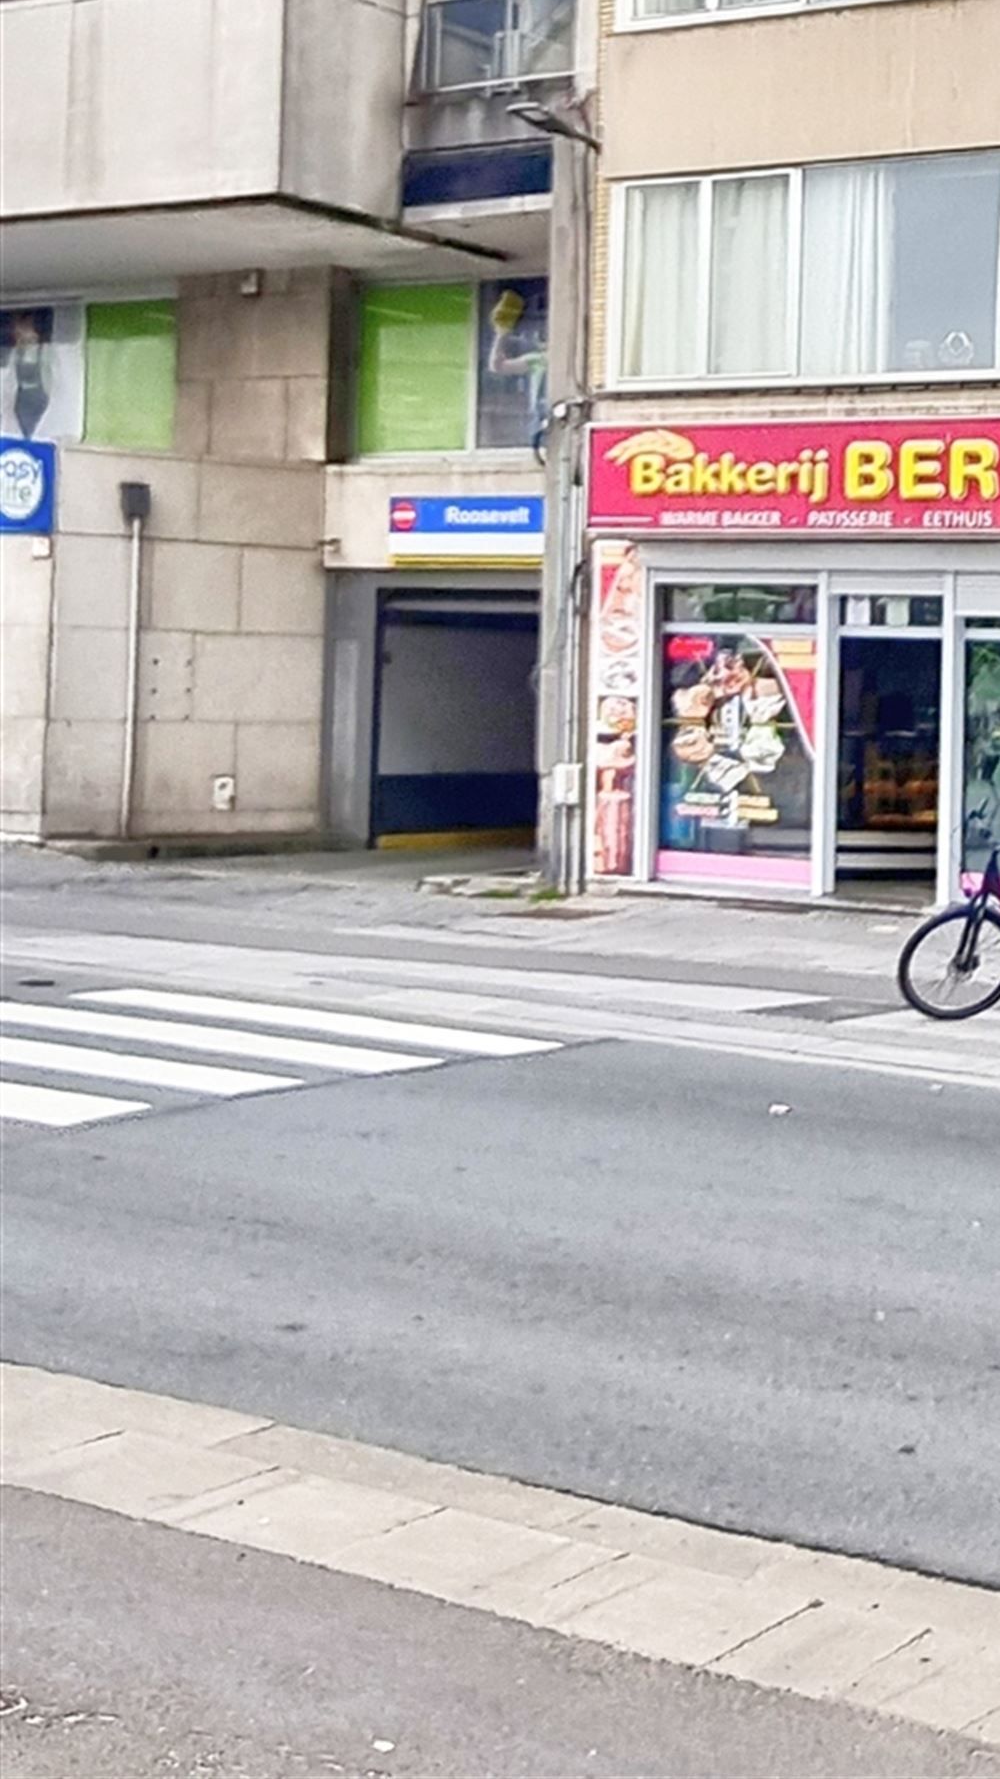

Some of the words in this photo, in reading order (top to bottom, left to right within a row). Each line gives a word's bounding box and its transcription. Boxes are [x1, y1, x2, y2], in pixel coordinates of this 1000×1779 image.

[630, 449, 829, 503] Bakkerij
[445, 505, 530, 525] Roosevelt
[659, 511, 718, 526] WARME
[720, 511, 782, 526] BAKKER
[807, 510, 893, 527] PATISSERIE
[923, 510, 993, 527] EETHUIS
